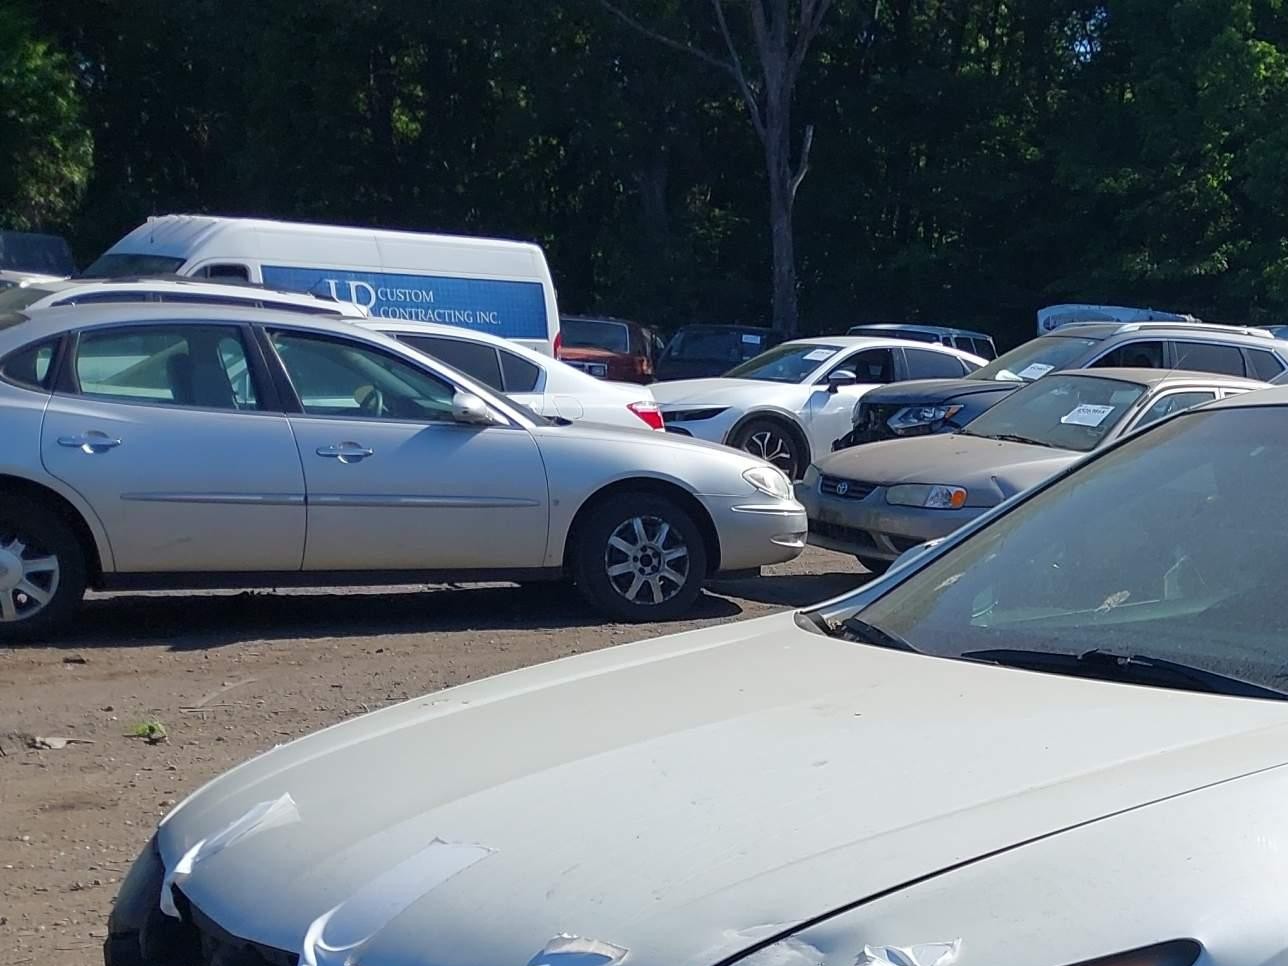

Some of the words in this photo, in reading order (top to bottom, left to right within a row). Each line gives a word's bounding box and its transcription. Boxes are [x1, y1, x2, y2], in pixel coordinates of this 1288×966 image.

[378, 287, 434, 303] CUSTOM
[380, 306, 473, 323] CONTRACTING
[476, 311, 502, 325] INC.
